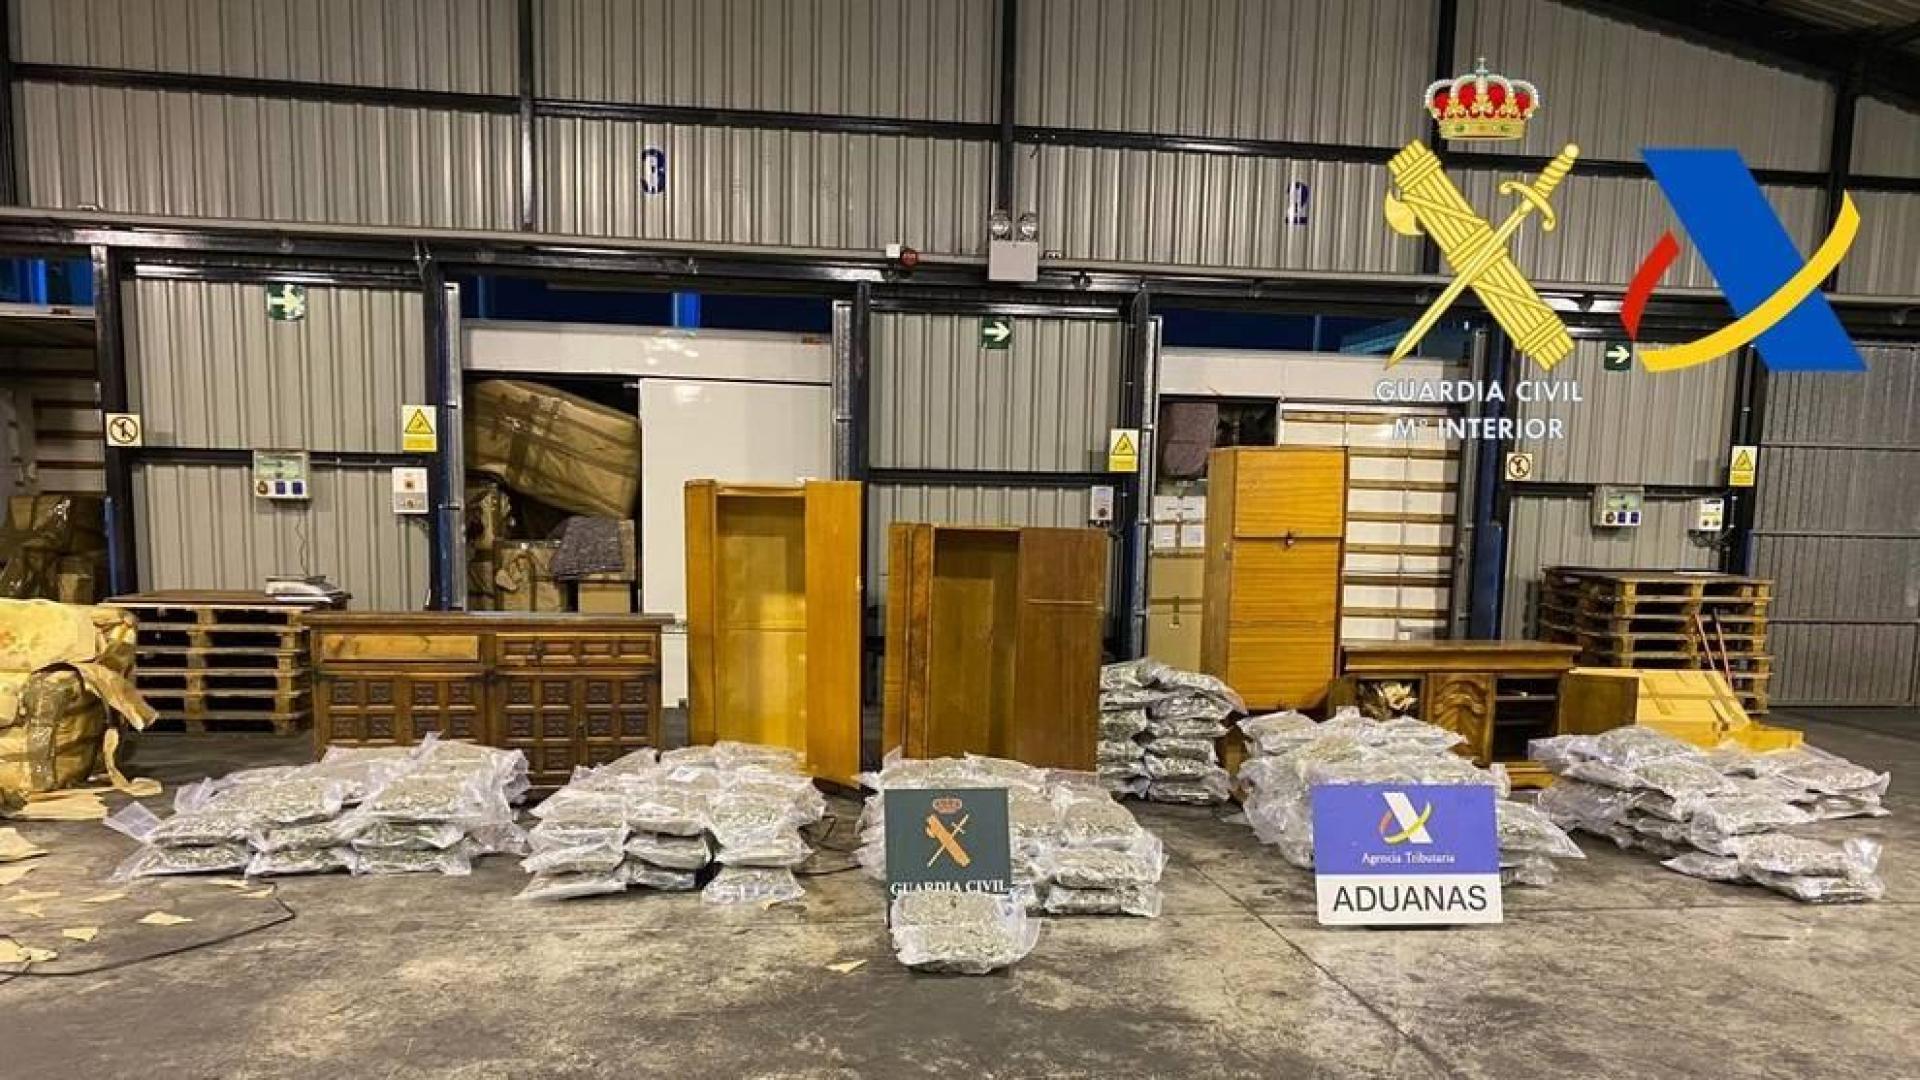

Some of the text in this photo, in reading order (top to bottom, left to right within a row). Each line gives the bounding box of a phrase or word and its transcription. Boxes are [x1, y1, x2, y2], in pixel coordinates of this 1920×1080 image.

[640, 148, 666, 194] 3
[1362, 851, 1455, 865] Agencia Tributaria
[1333, 885, 1487, 912] ADUANAS
